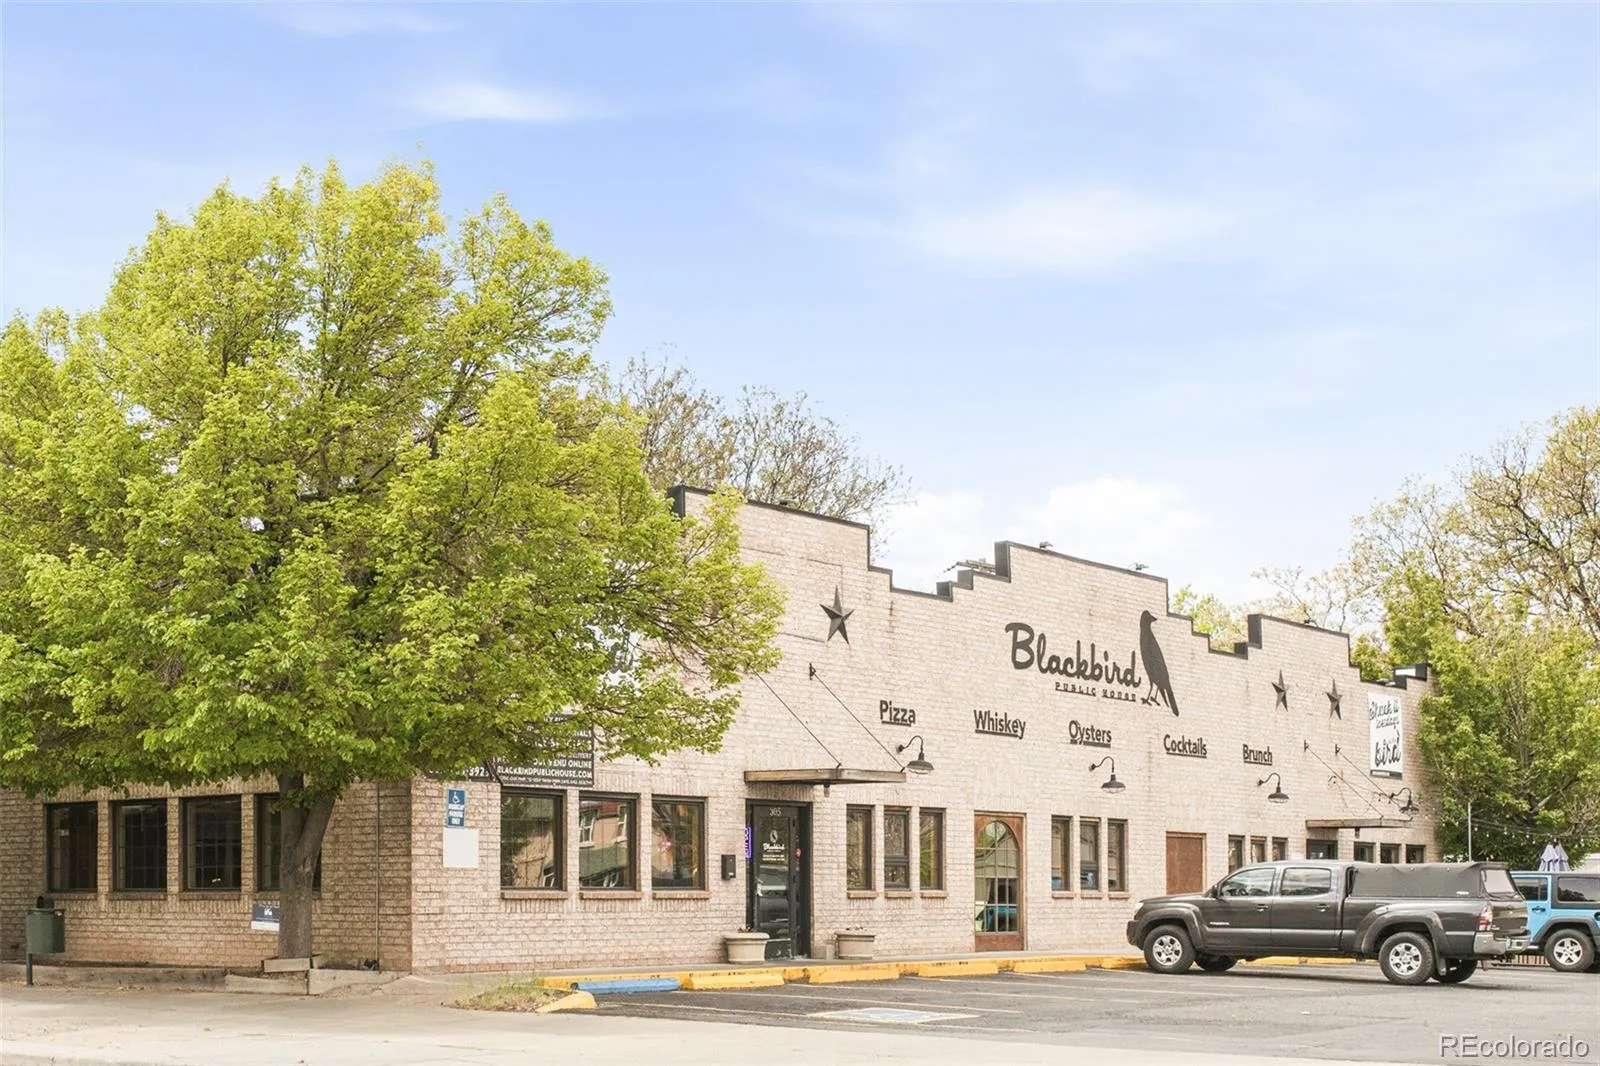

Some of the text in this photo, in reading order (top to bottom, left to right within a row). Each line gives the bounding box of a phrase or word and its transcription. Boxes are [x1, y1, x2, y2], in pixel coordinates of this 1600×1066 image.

[1005, 622, 1141, 688] Blackbird
[1055, 681, 1137, 702] PUBLIC HOUSE
[880, 699, 916, 725] Pizza
[974, 709, 1026, 739] Whiskey
[1069, 720, 1112, 746] Oysters
[1164, 734, 1207, 757] Cocktails
[1243, 744, 1273, 764] Brunch
[567, 760, 592, 769] ONLINE
